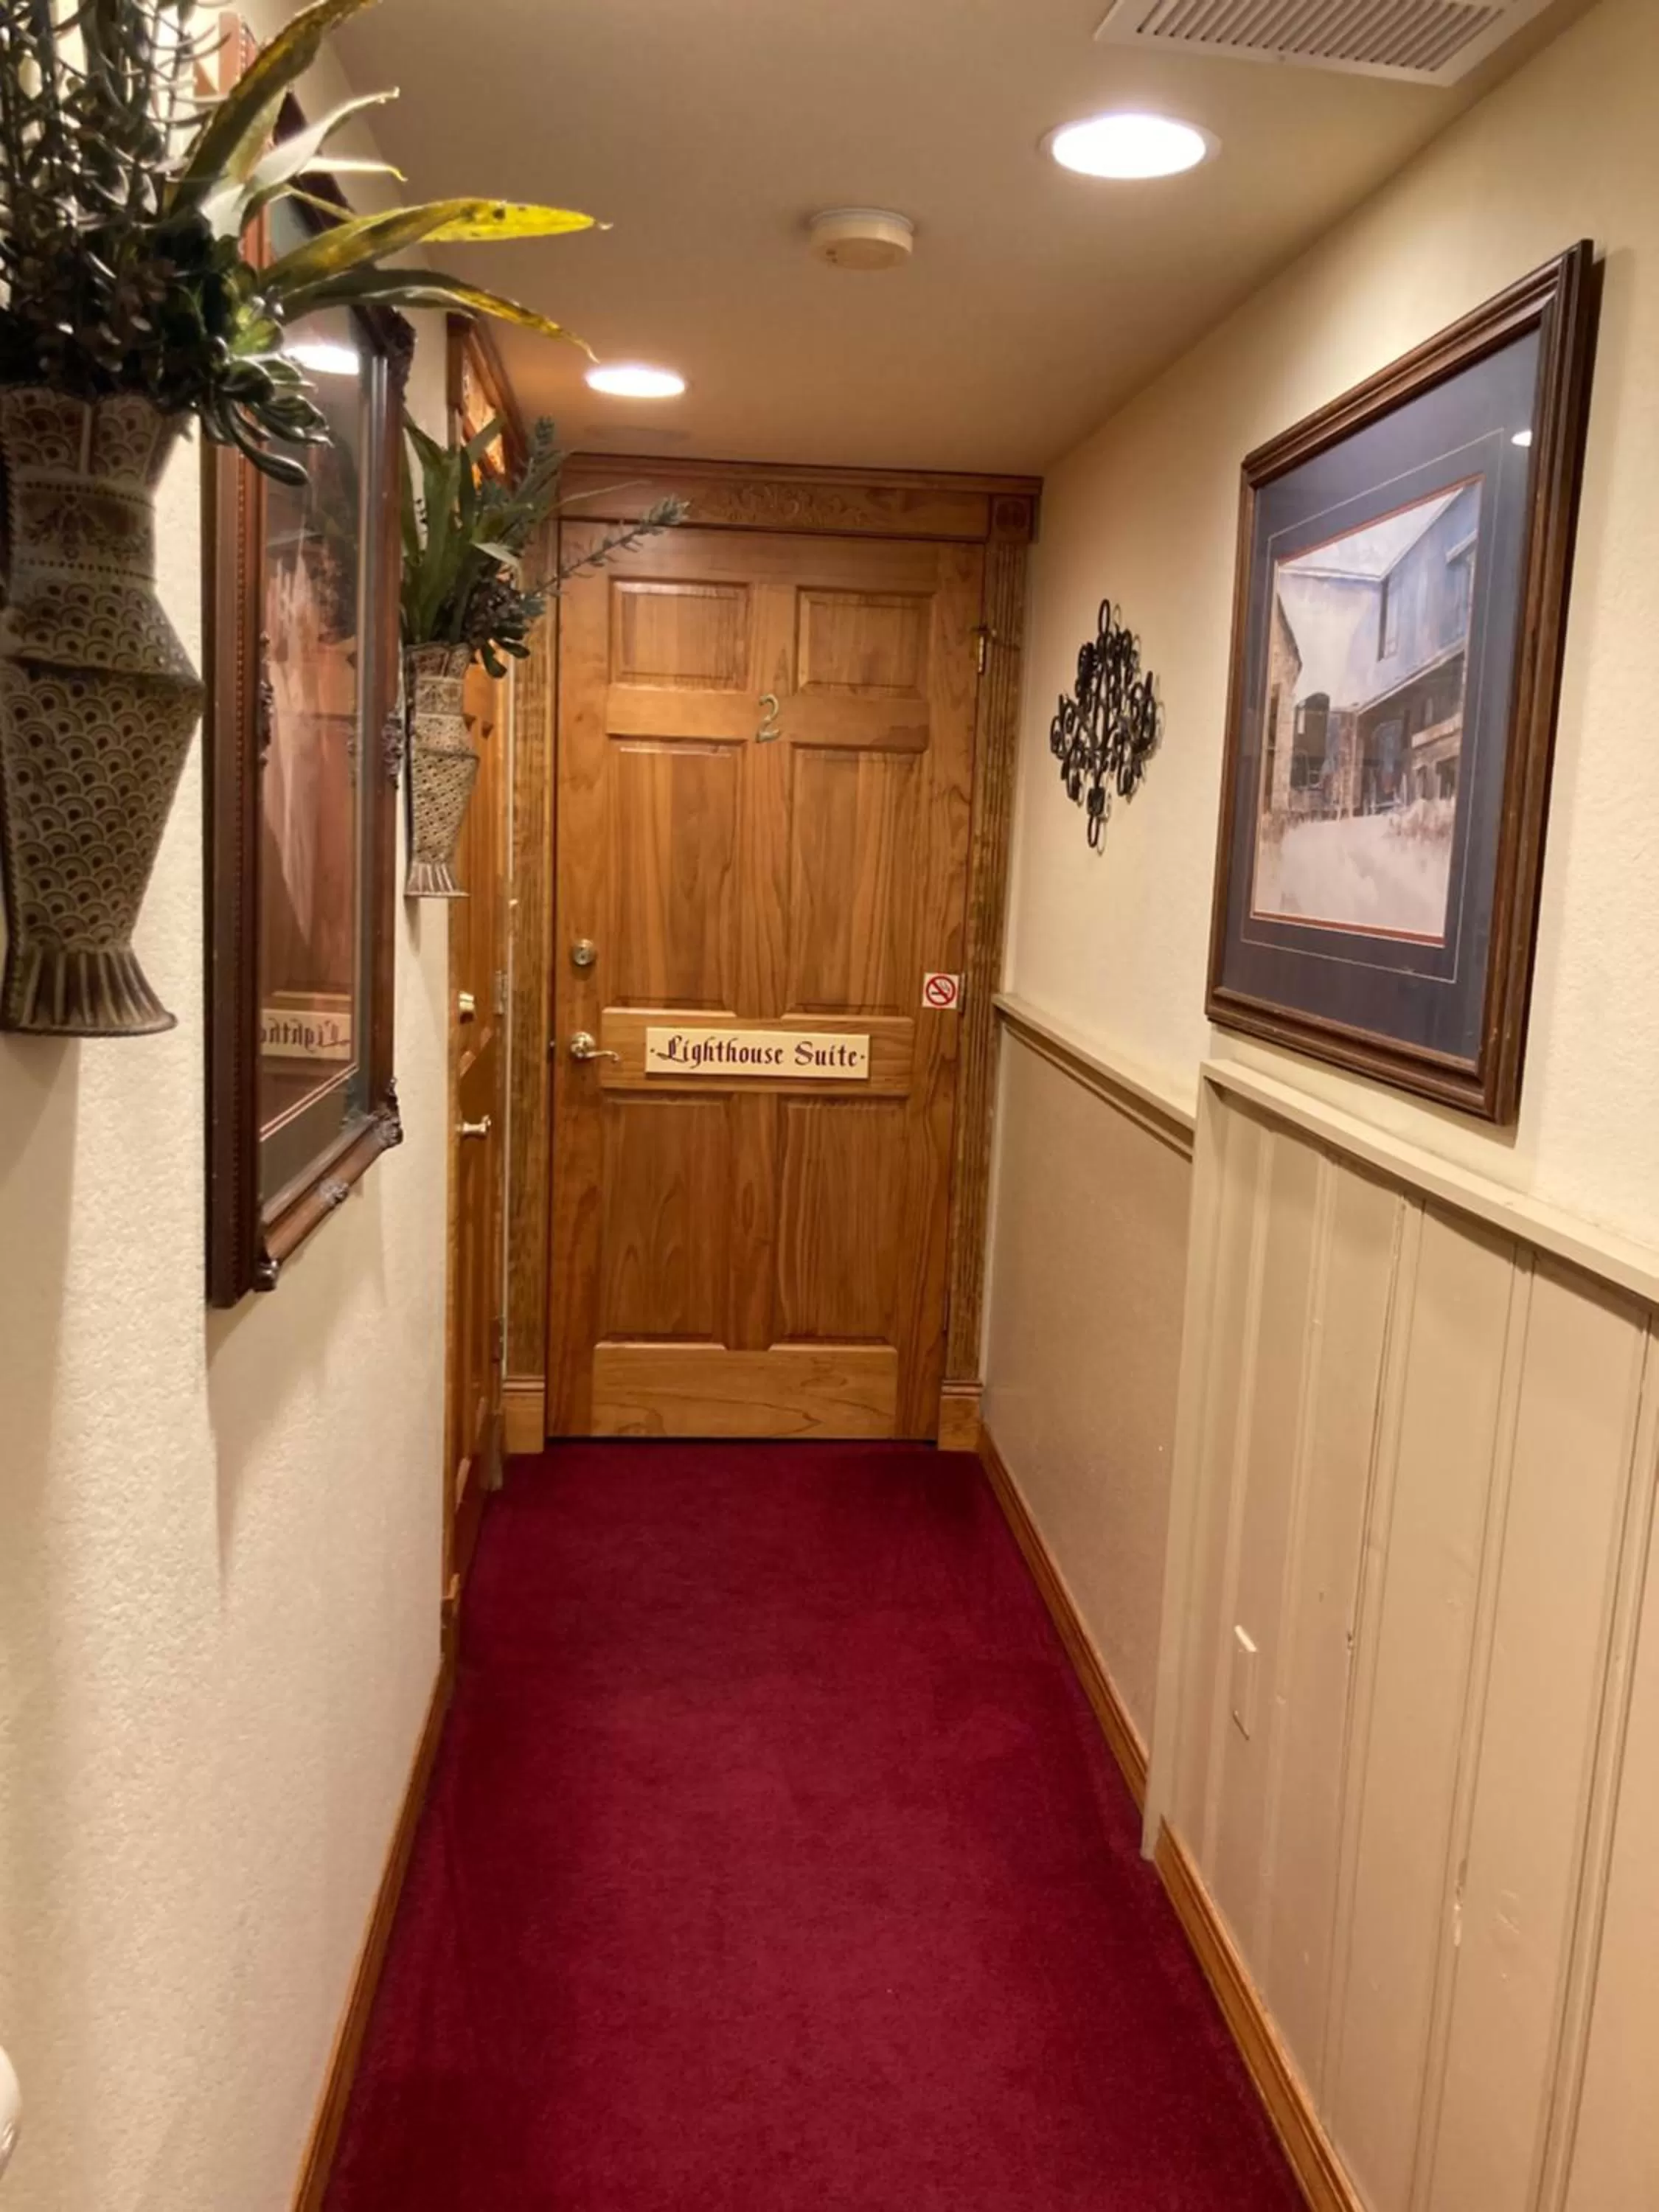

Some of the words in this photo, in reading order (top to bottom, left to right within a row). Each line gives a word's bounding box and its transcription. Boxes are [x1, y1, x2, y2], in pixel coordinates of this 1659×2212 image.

[756, 693, 780, 743] 2
[655, 1034, 783, 1068] Lighthouse
[793, 1040, 858, 1067] Suite
